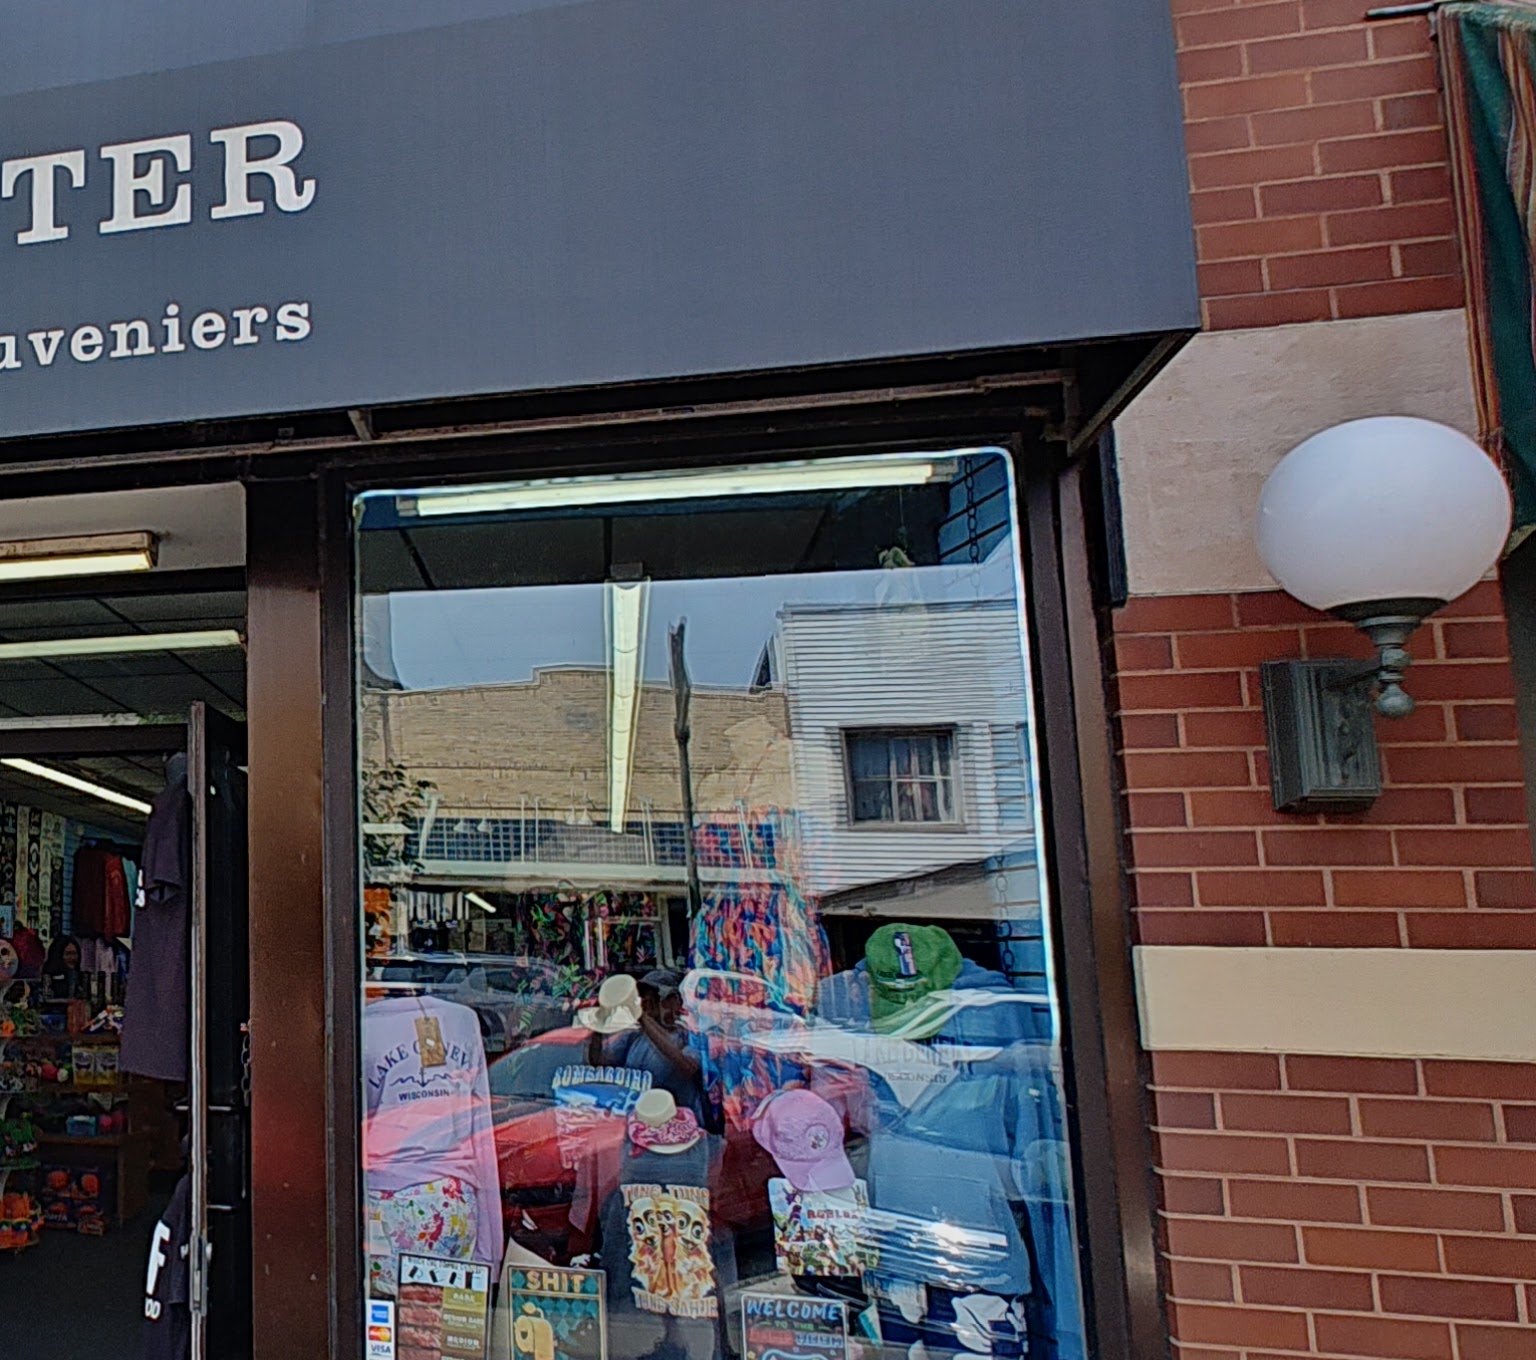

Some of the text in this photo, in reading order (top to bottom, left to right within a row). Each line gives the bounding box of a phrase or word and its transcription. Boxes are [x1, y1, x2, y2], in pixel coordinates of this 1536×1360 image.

[368, 1044, 409, 1089] LAKE
[398, 1089, 450, 1101] WISCONSIN
[526, 1270, 585, 1293] SHIT
[747, 1300, 840, 1321] WELCOME
[370, 1344, 391, 1353] VISA
